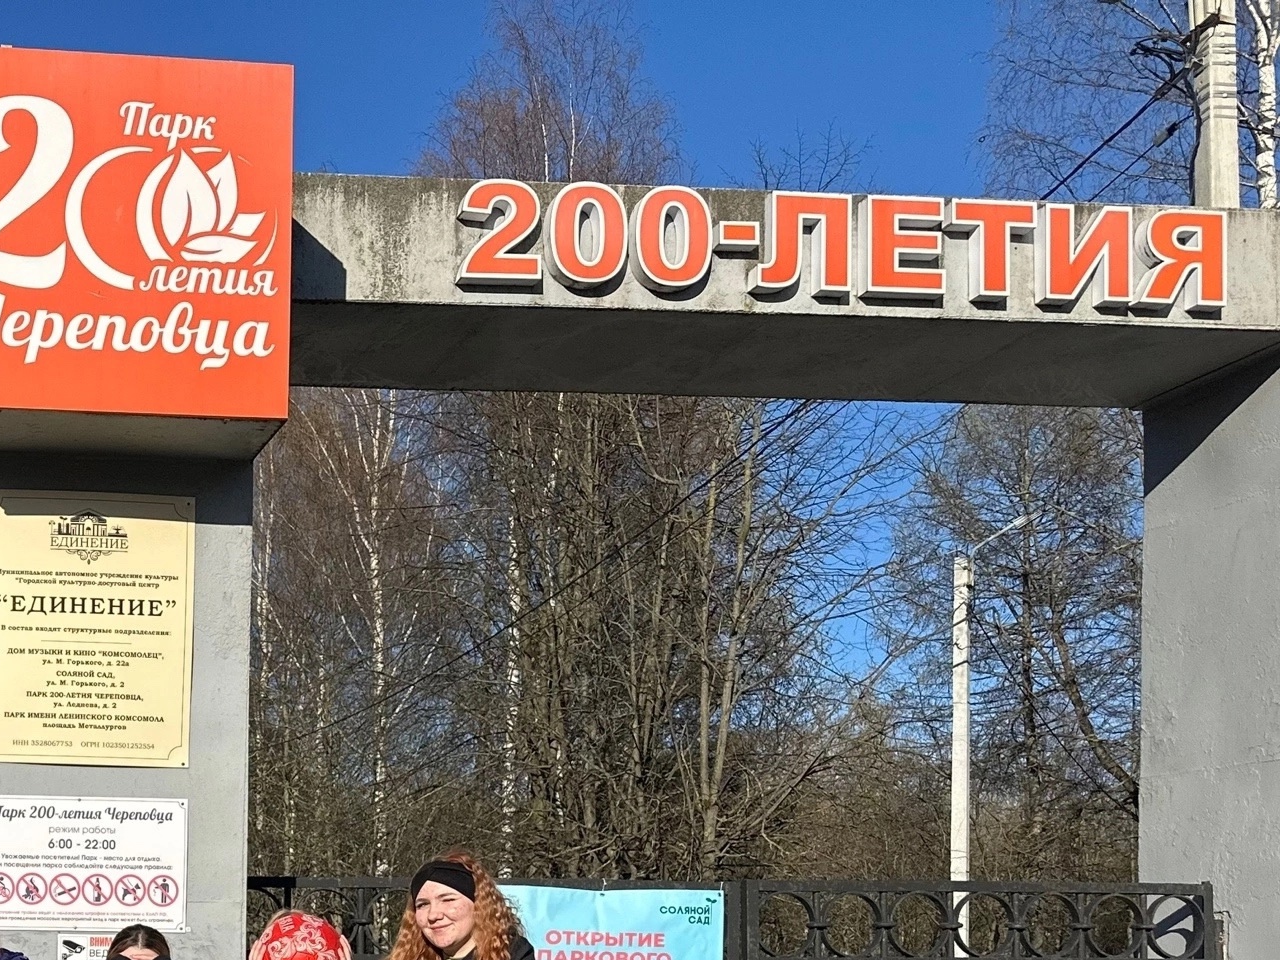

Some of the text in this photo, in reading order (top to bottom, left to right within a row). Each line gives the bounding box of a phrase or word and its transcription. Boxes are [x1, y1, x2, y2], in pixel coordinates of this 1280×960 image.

[119, 101, 216, 152] Парк
[456, 178, 1227, 308] 200-ЛЕТИЯ
[139, 264, 279, 297] летия
[50, 536, 129, 549] ЕДИНЕНИЕ
[71, 680, 108, 688] Горького,
[94, 693, 144, 701] ЧЕРЕПОВЦА,
[78, 723, 127, 731] Металлургов
[29, 805, 102, 820] 200-летия
[104, 806, 174, 824] Череповца
[48, 825, 116, 835] режим работы
[48, 839, 72, 849] 6:00
[84, 839, 116, 850] 22:00
[659, 904, 710, 916] СОЛЯНОЙ
[688, 915, 710, 925] САД
[545, 930, 665, 948] ОТКРЫТИЕ
